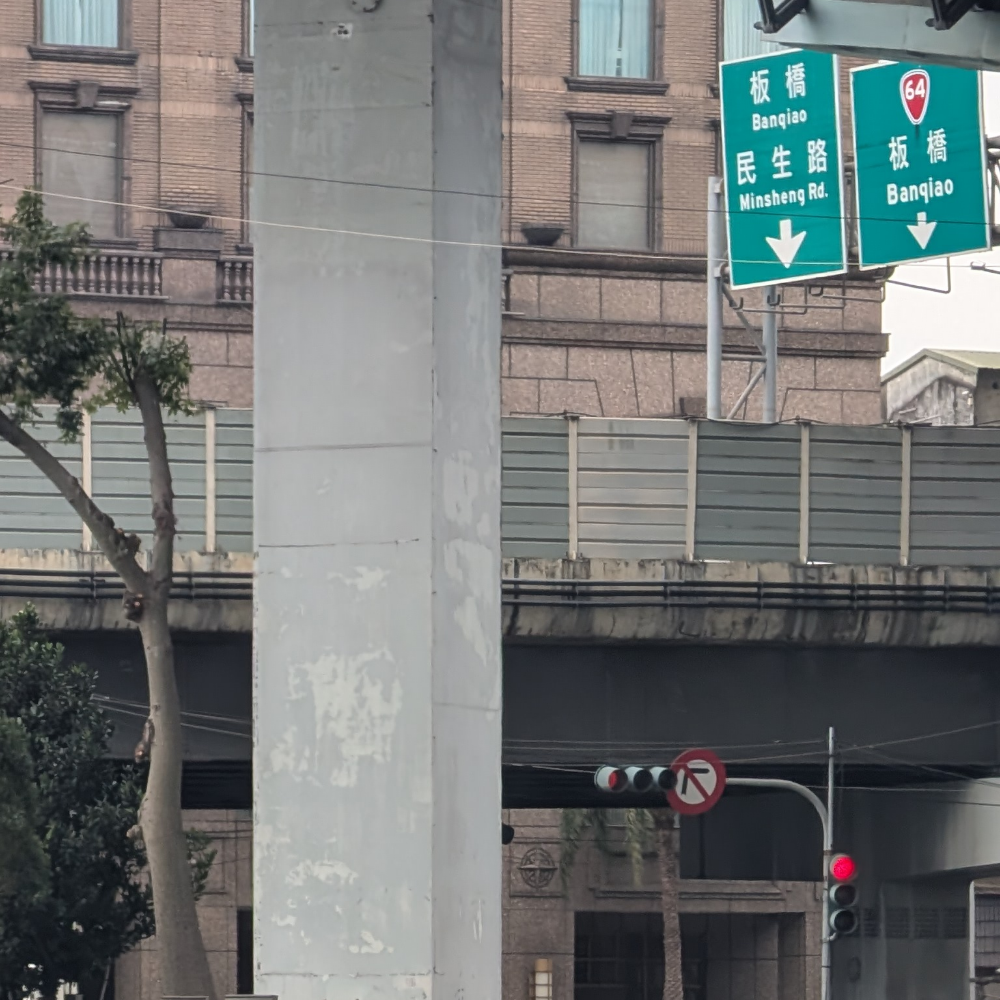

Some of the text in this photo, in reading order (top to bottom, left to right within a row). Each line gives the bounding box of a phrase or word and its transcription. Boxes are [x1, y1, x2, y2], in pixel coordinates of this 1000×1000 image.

[750, 63, 806, 105] 板橋
[905, 81, 925, 100] 64
[752, 108, 807, 131] Banqiao
[736, 139, 828, 186] 民生路
[889, 128, 947, 171] 板橋
[739, 182, 829, 212] Minsheng Rd.
[887, 177, 954, 205] Banqiao
